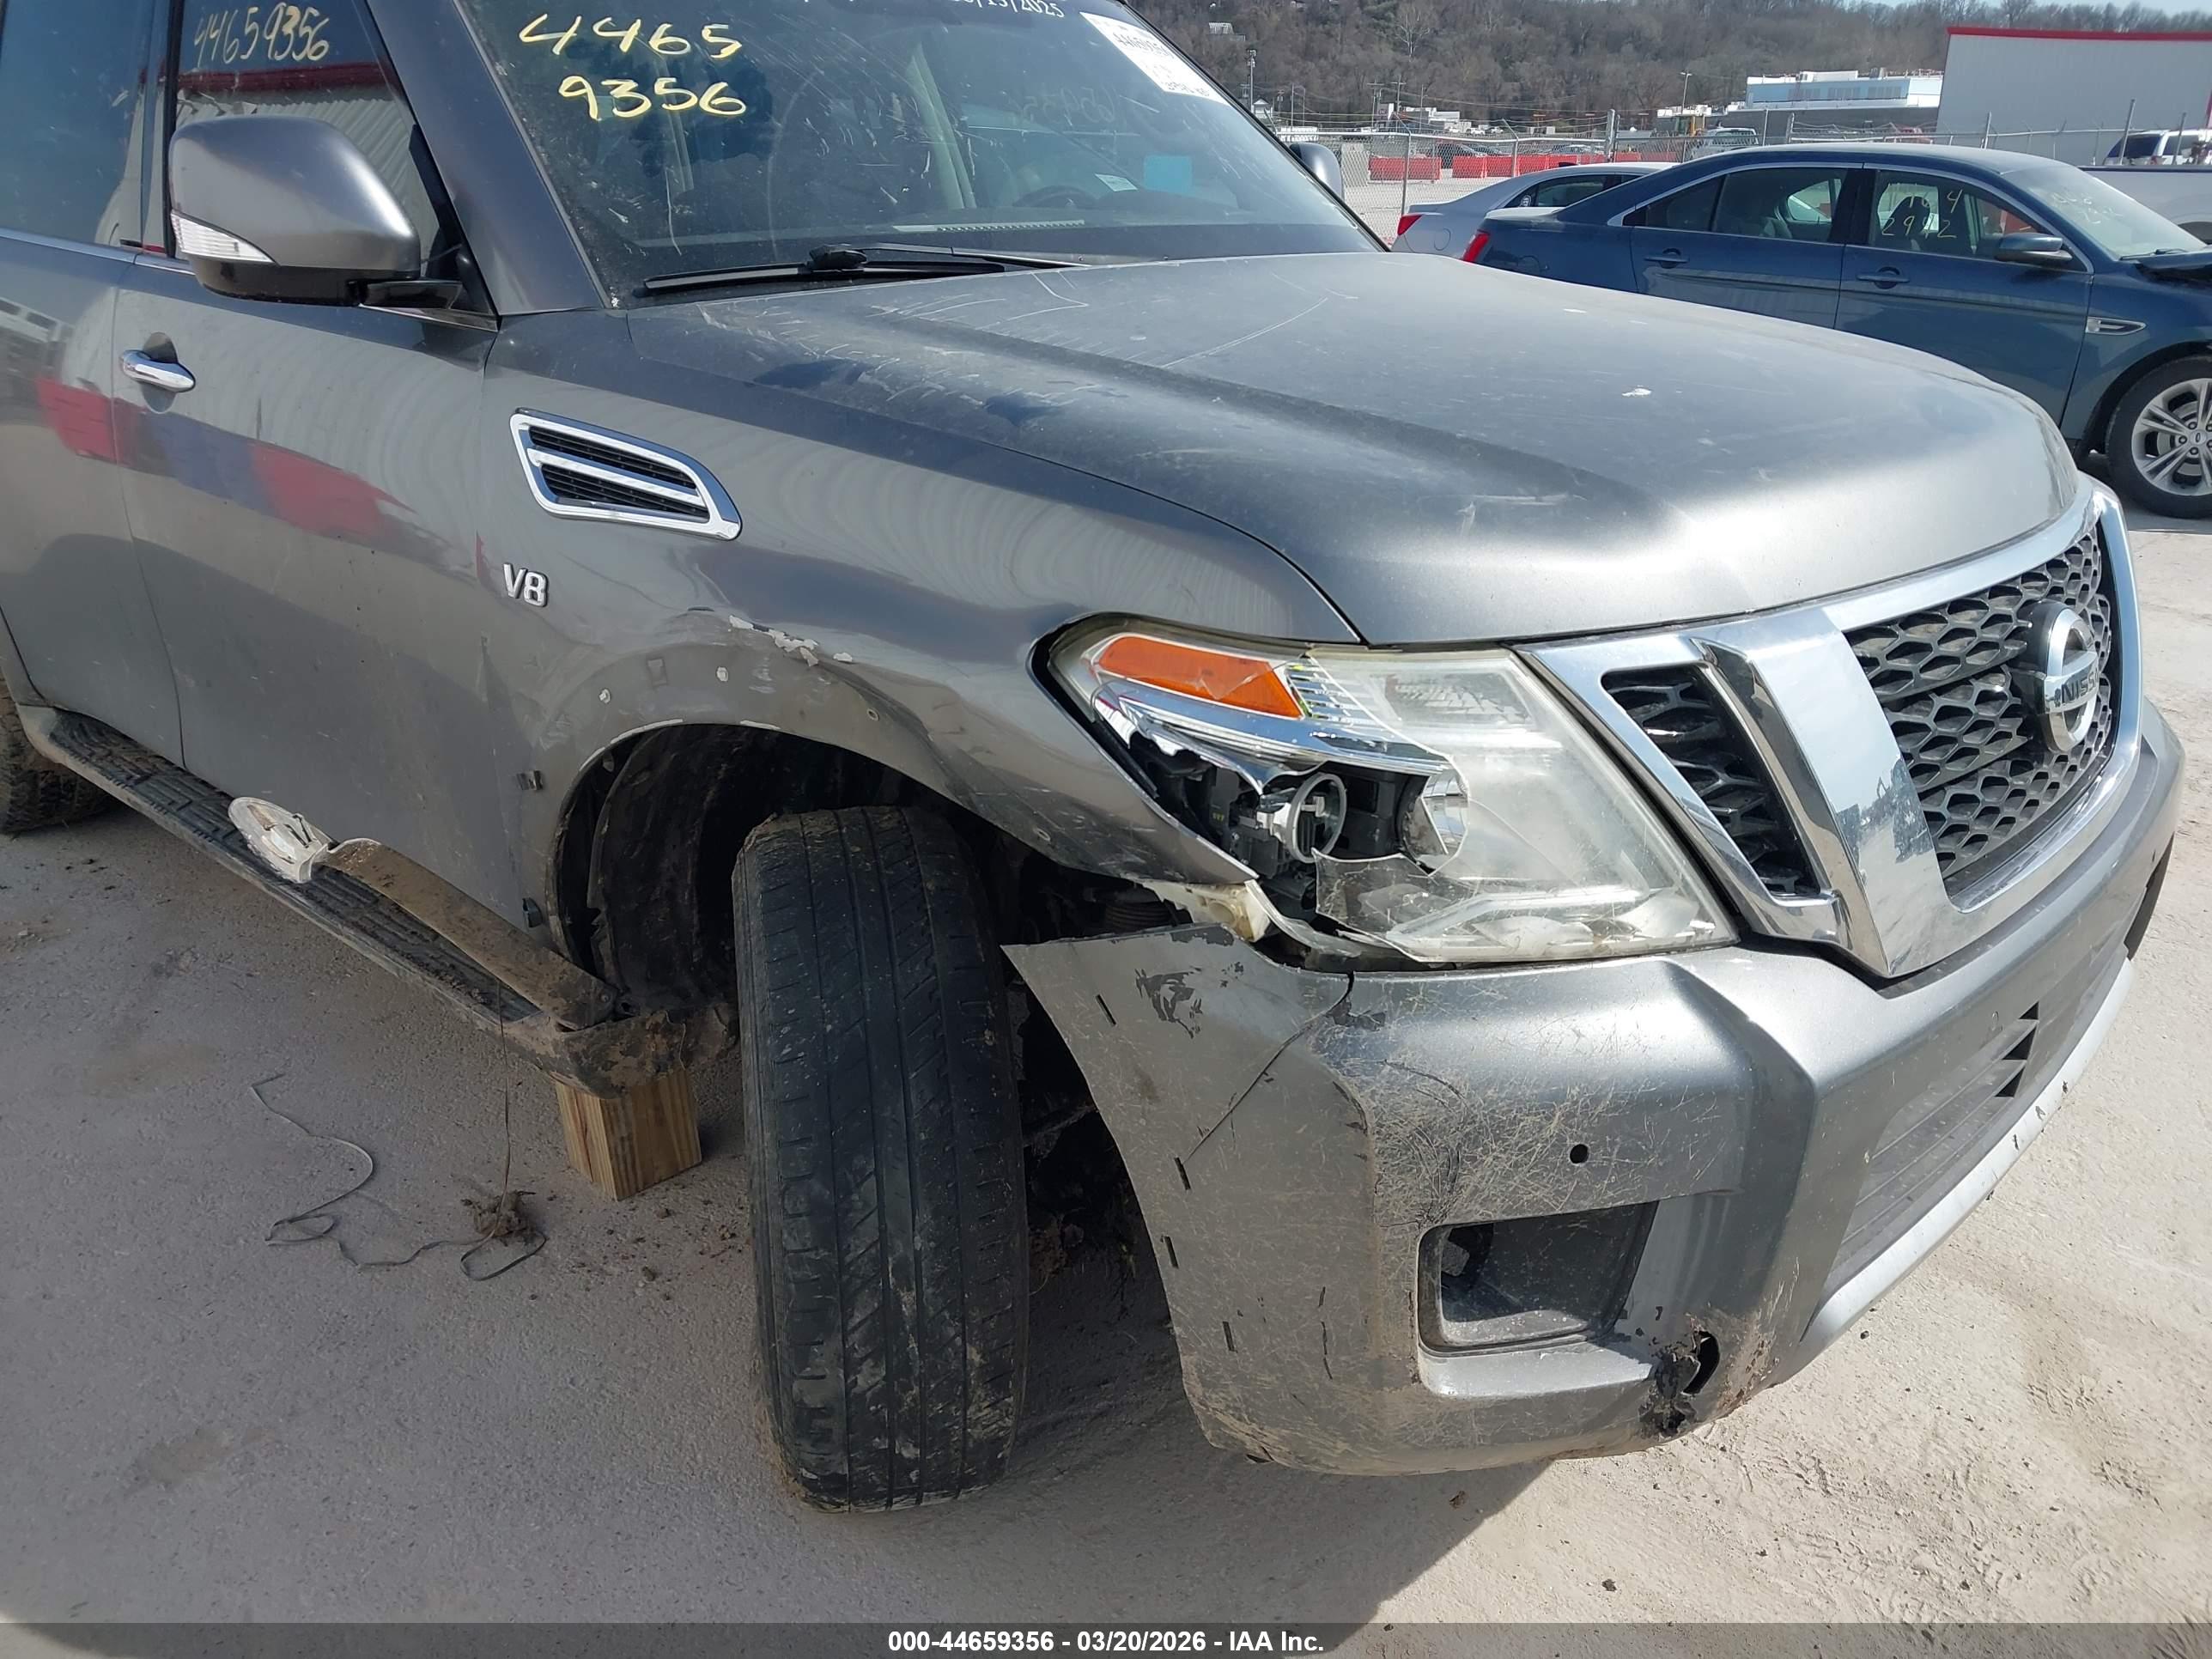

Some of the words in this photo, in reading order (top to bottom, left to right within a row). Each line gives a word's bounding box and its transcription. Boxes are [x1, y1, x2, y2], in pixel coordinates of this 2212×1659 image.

[519, 14, 743, 58] 4465
[559, 76, 748, 121] 9356
[503, 562, 548, 607] V8
